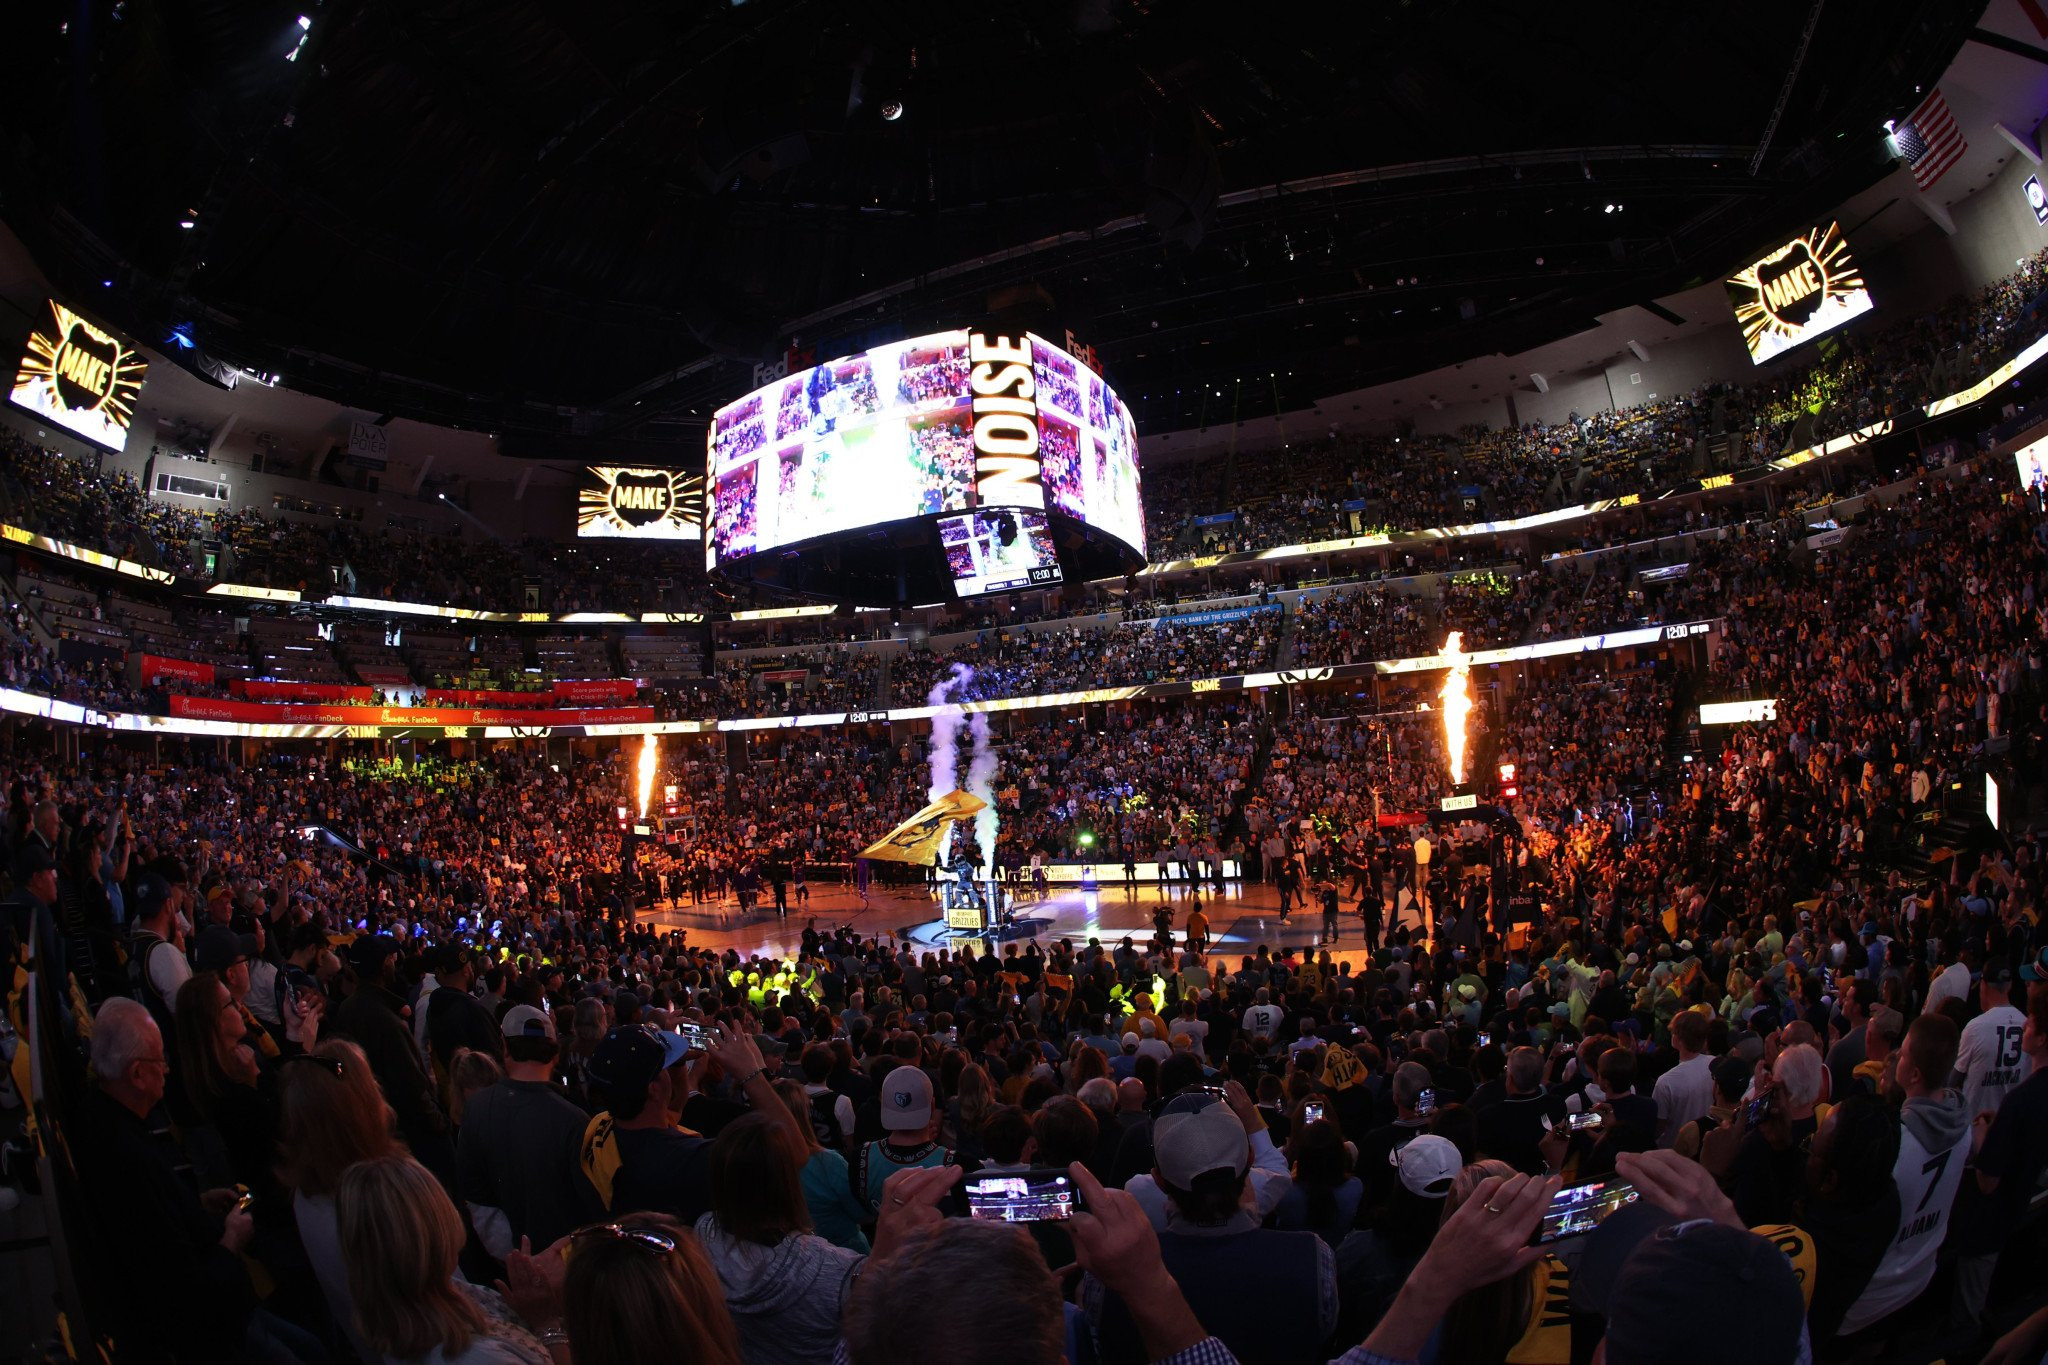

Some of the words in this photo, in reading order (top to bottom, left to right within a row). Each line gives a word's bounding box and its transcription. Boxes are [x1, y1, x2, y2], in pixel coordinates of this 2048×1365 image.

[1763, 259, 1821, 313] MAKE
[58, 341, 112, 397] MAKE
[970, 333, 1045, 510] NOISE
[615, 485, 667, 510] MAKE
[1032, 569, 1051, 580] 12:00
[1222, 610, 1248, 619] GRIZZLIES
[1665, 624, 1688, 640] 12:00
[1192, 678, 1221, 693] SOME
[209, 709, 233, 718] FanDeck
[314, 714, 344, 722] FanDeck
[411, 716, 438, 724] FanDeck
[850, 712, 868, 723] 12:00
[499, 717, 524, 725] FanDeck
[1445, 799, 1463, 809] WITH
[1464, 797, 1473, 807] US
[951, 917, 980, 927] GRIZZLIES
[1255, 1012, 1270, 1026] 12
[1995, 1025, 2023, 1068] 13
[1916, 1149, 1952, 1214] 7
